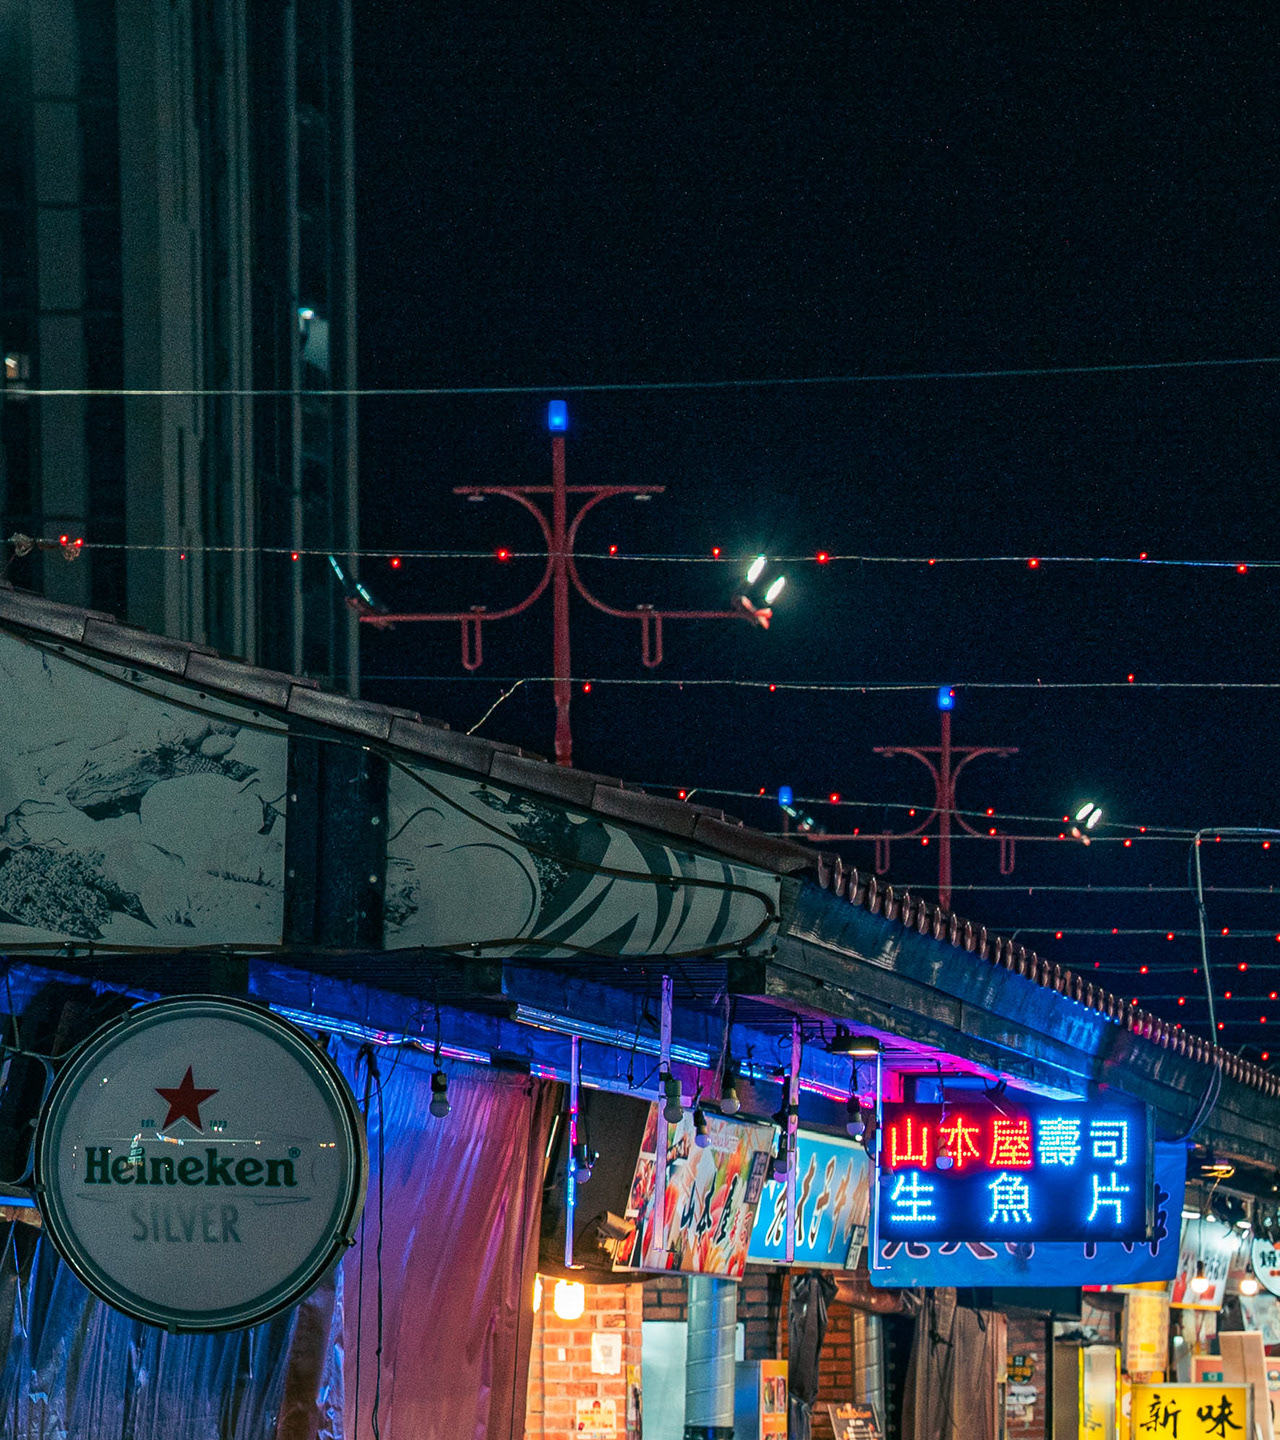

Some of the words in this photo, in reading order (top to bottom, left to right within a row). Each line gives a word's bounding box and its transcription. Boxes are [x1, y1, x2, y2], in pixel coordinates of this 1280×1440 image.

[890, 1116, 1128, 1167] 山本屋壽司
[84, 1147, 299, 1187] Heineken
[890, 1171, 1130, 1223] 生魚片
[131, 1202, 242, 1243] SILVER
[1139, 1393, 1244, 1439] 新味
